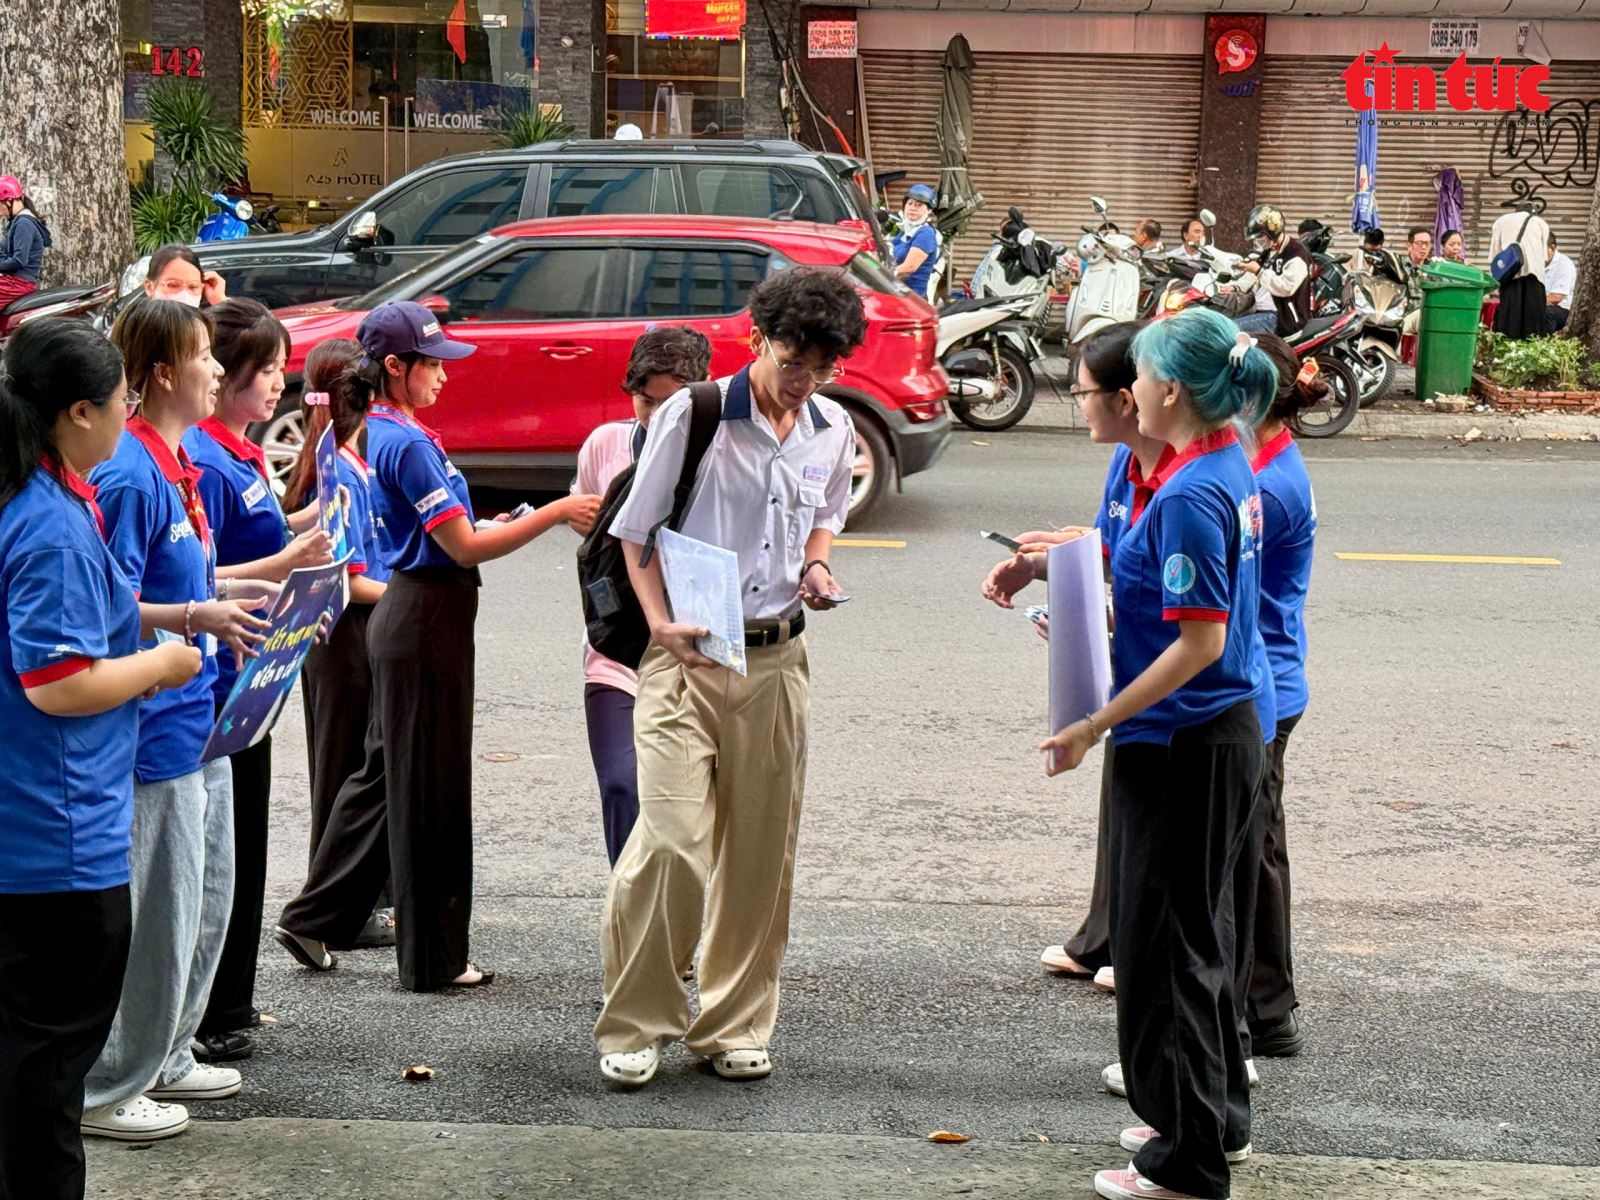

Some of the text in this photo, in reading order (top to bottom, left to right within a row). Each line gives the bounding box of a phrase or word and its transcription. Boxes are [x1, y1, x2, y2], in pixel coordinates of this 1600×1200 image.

[1430, 29, 1478, 47] 0389 540 179
[151, 45, 202, 78] 142
[310, 109, 380, 126] WELCOME
[413, 112, 483, 129] WELCOME
[337, 173, 384, 186] HOTEL
